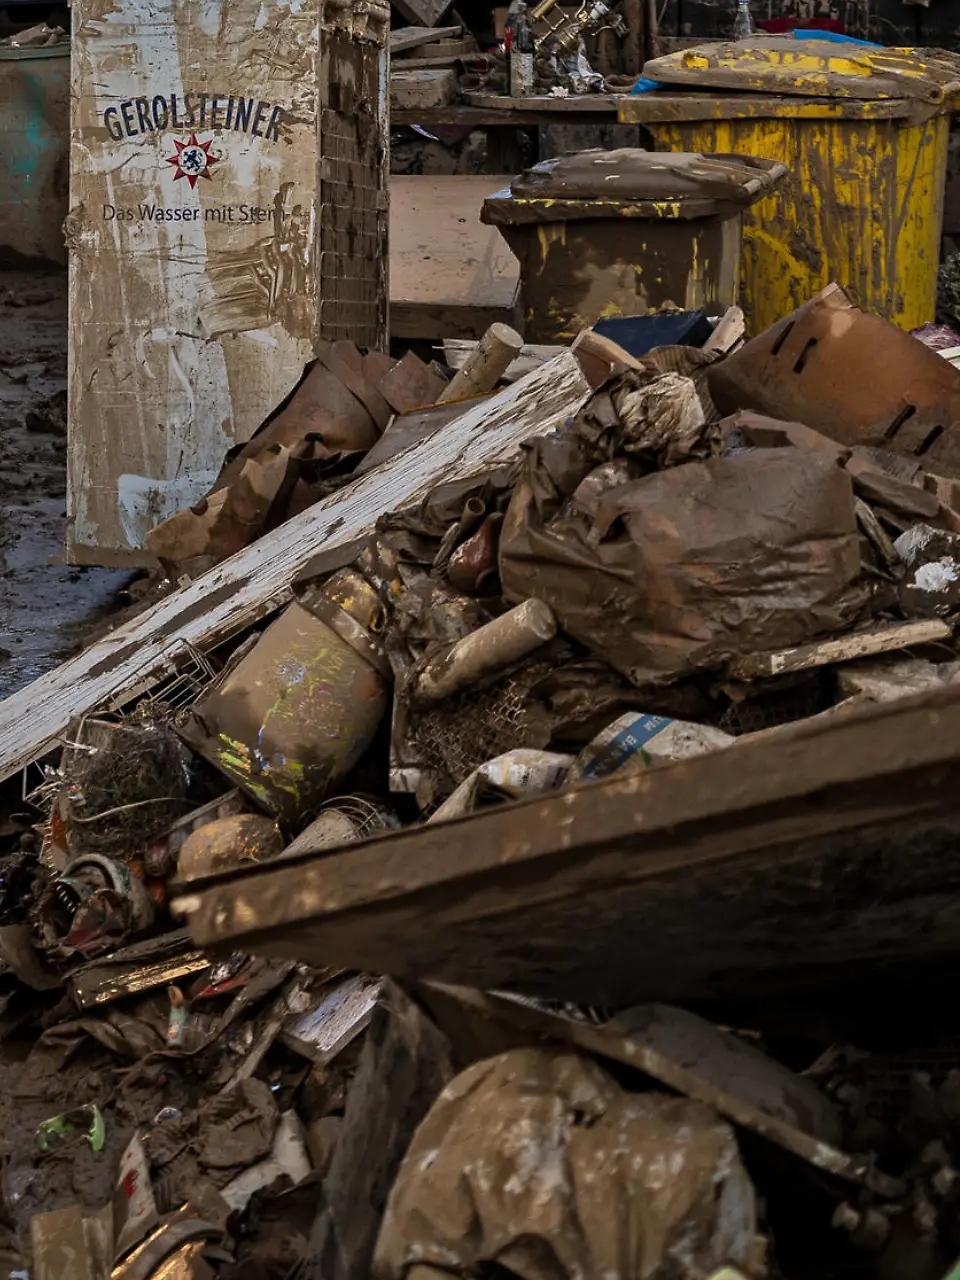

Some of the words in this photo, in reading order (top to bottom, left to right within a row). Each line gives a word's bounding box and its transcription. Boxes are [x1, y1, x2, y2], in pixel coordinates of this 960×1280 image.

[104, 93, 284, 142] GEROLSTEINER
[103, 205, 133, 221] Das
[138, 205, 200, 221] Wasser
[205, 205, 233, 221] mit
